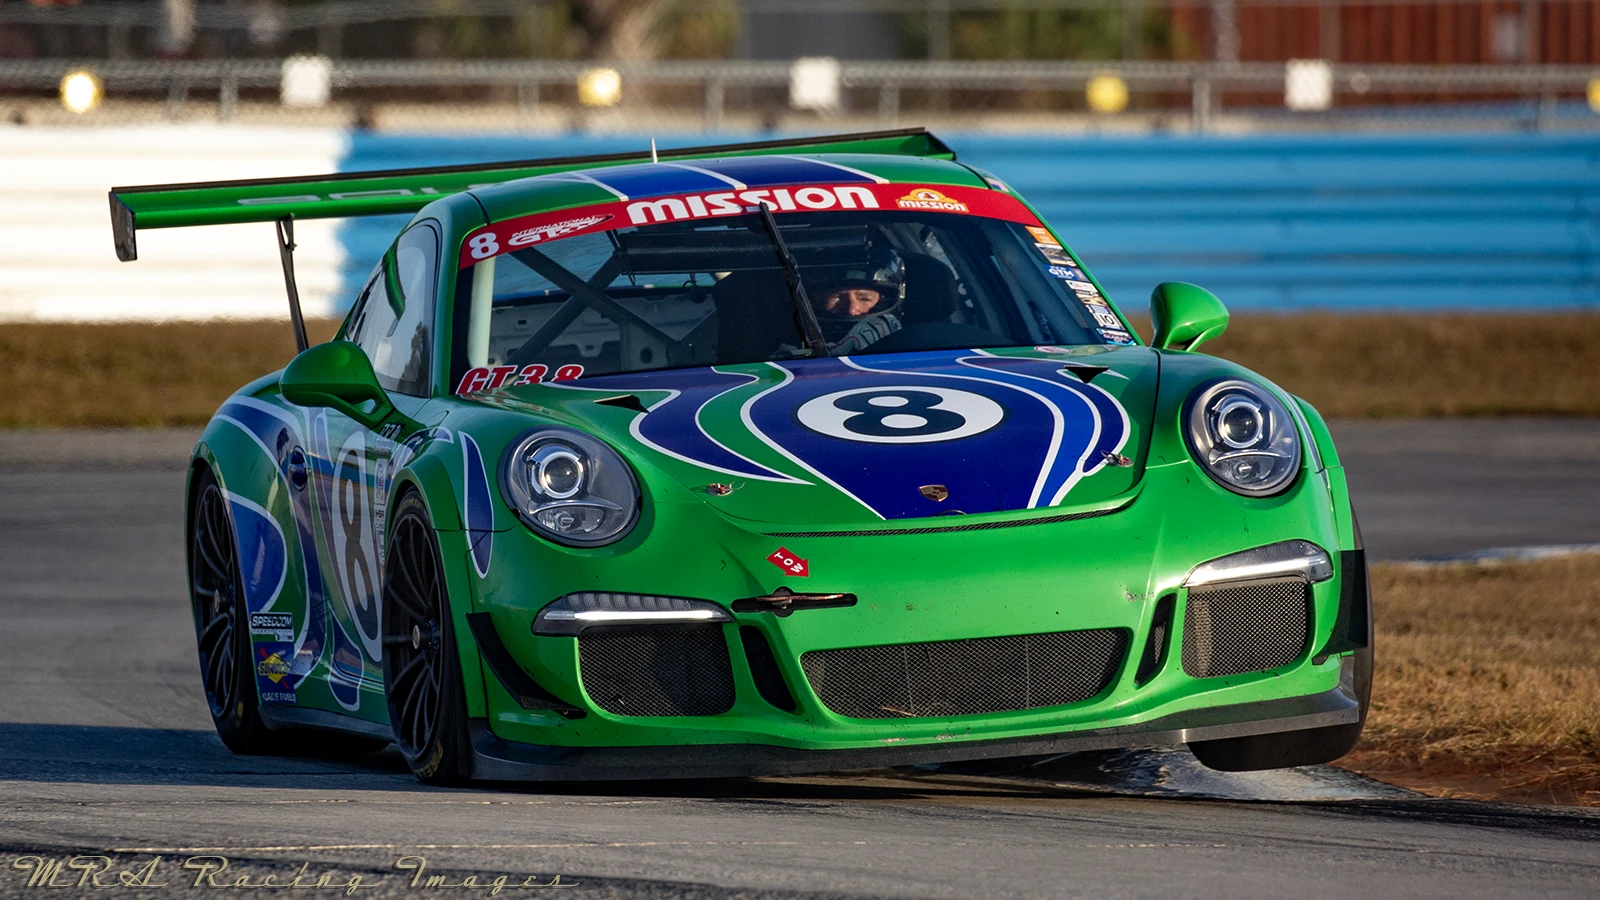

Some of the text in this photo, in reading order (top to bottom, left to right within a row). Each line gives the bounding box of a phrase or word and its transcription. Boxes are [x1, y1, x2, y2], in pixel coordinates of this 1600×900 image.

[511, 215, 599, 237] INTERNATIONAL
[468, 232, 500, 259] 8
[832, 390, 967, 437] 8
[337, 449, 379, 640] 8
[773, 551, 804, 574] TOW
[251, 614, 293, 628] SPEEDCOM
[260, 662, 291, 676] SUNOCO
[280, 692, 297, 705] FUELS
